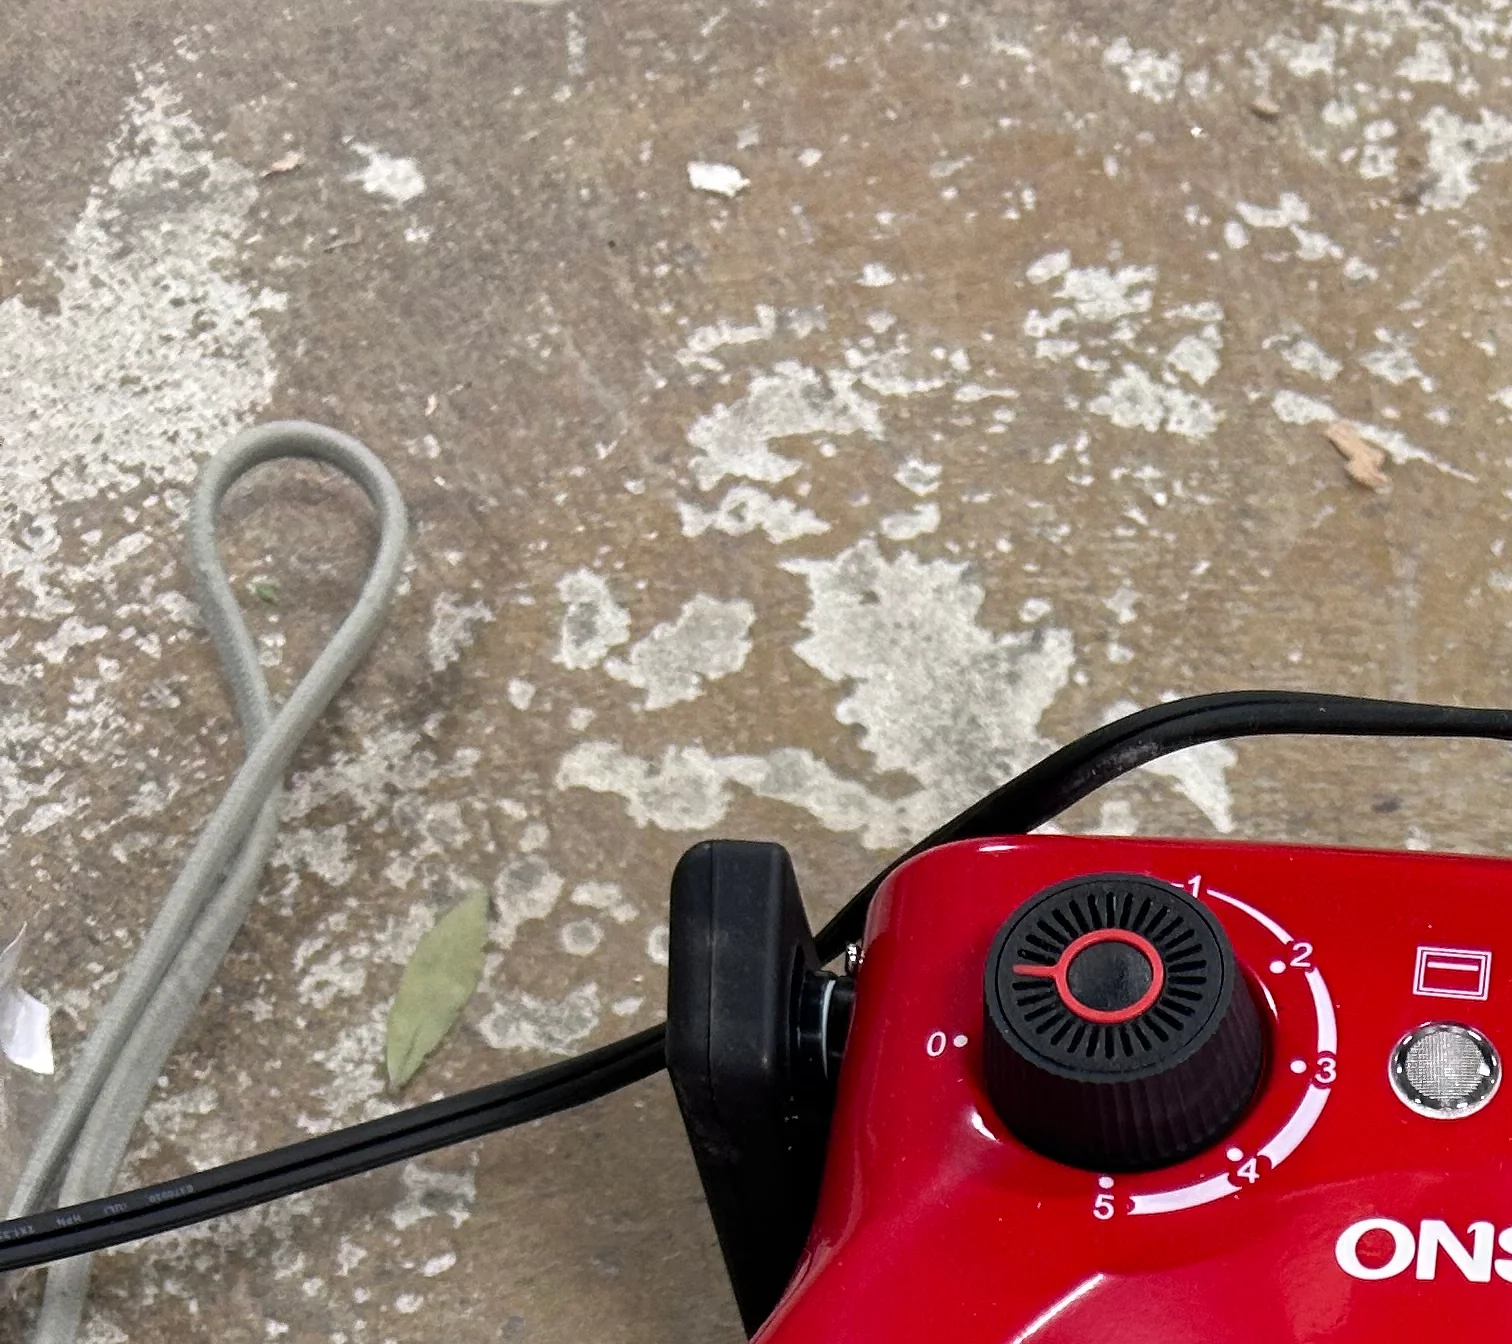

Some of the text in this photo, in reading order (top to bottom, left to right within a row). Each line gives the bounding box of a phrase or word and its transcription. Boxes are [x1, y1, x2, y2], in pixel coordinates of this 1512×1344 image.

[1187, 874, 1202, 899] 1
[1290, 942, 1314, 968] 2
[926, 1030, 947, 1057] 0
[1314, 1058, 1337, 1084] 3
[1236, 1159, 1260, 1184] 4
[1093, 1195, 1115, 1221] 5
